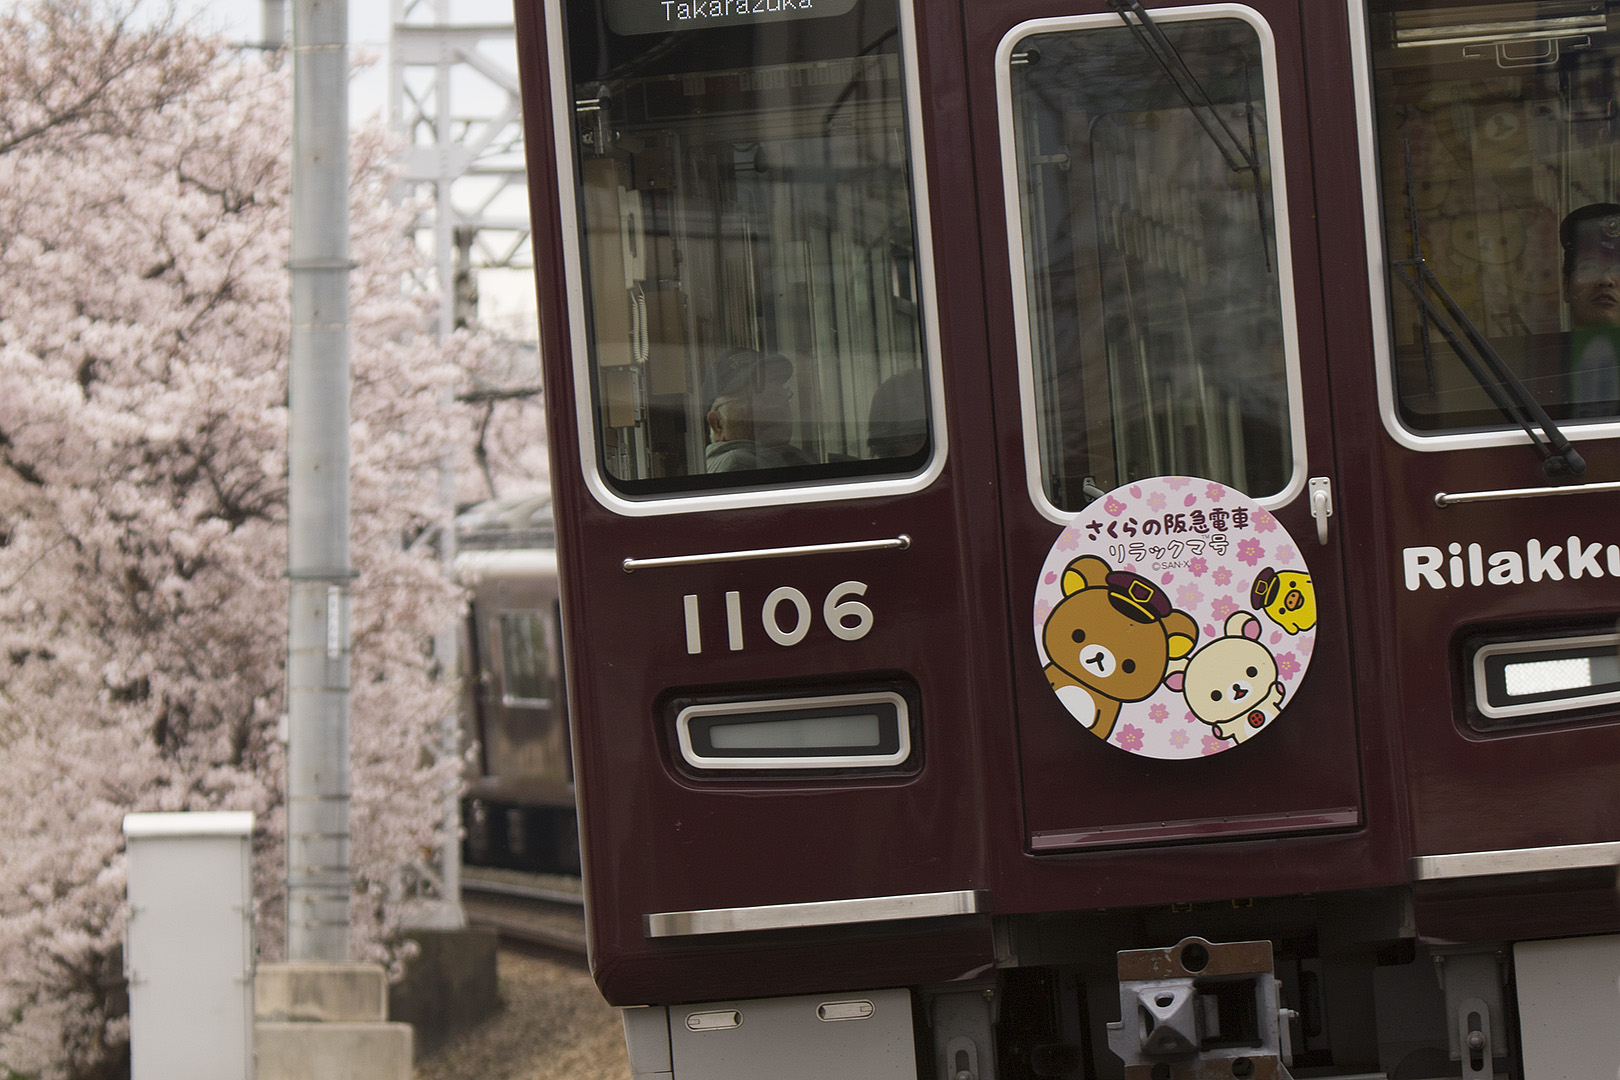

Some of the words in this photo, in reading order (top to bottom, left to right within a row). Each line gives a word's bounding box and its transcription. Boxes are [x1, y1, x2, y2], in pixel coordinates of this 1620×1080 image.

[1084, 506, 1249, 541] さくらの阪急電車
[1108, 533, 1230, 563] リラックマ号
[683, 580, 874, 655] 1106
